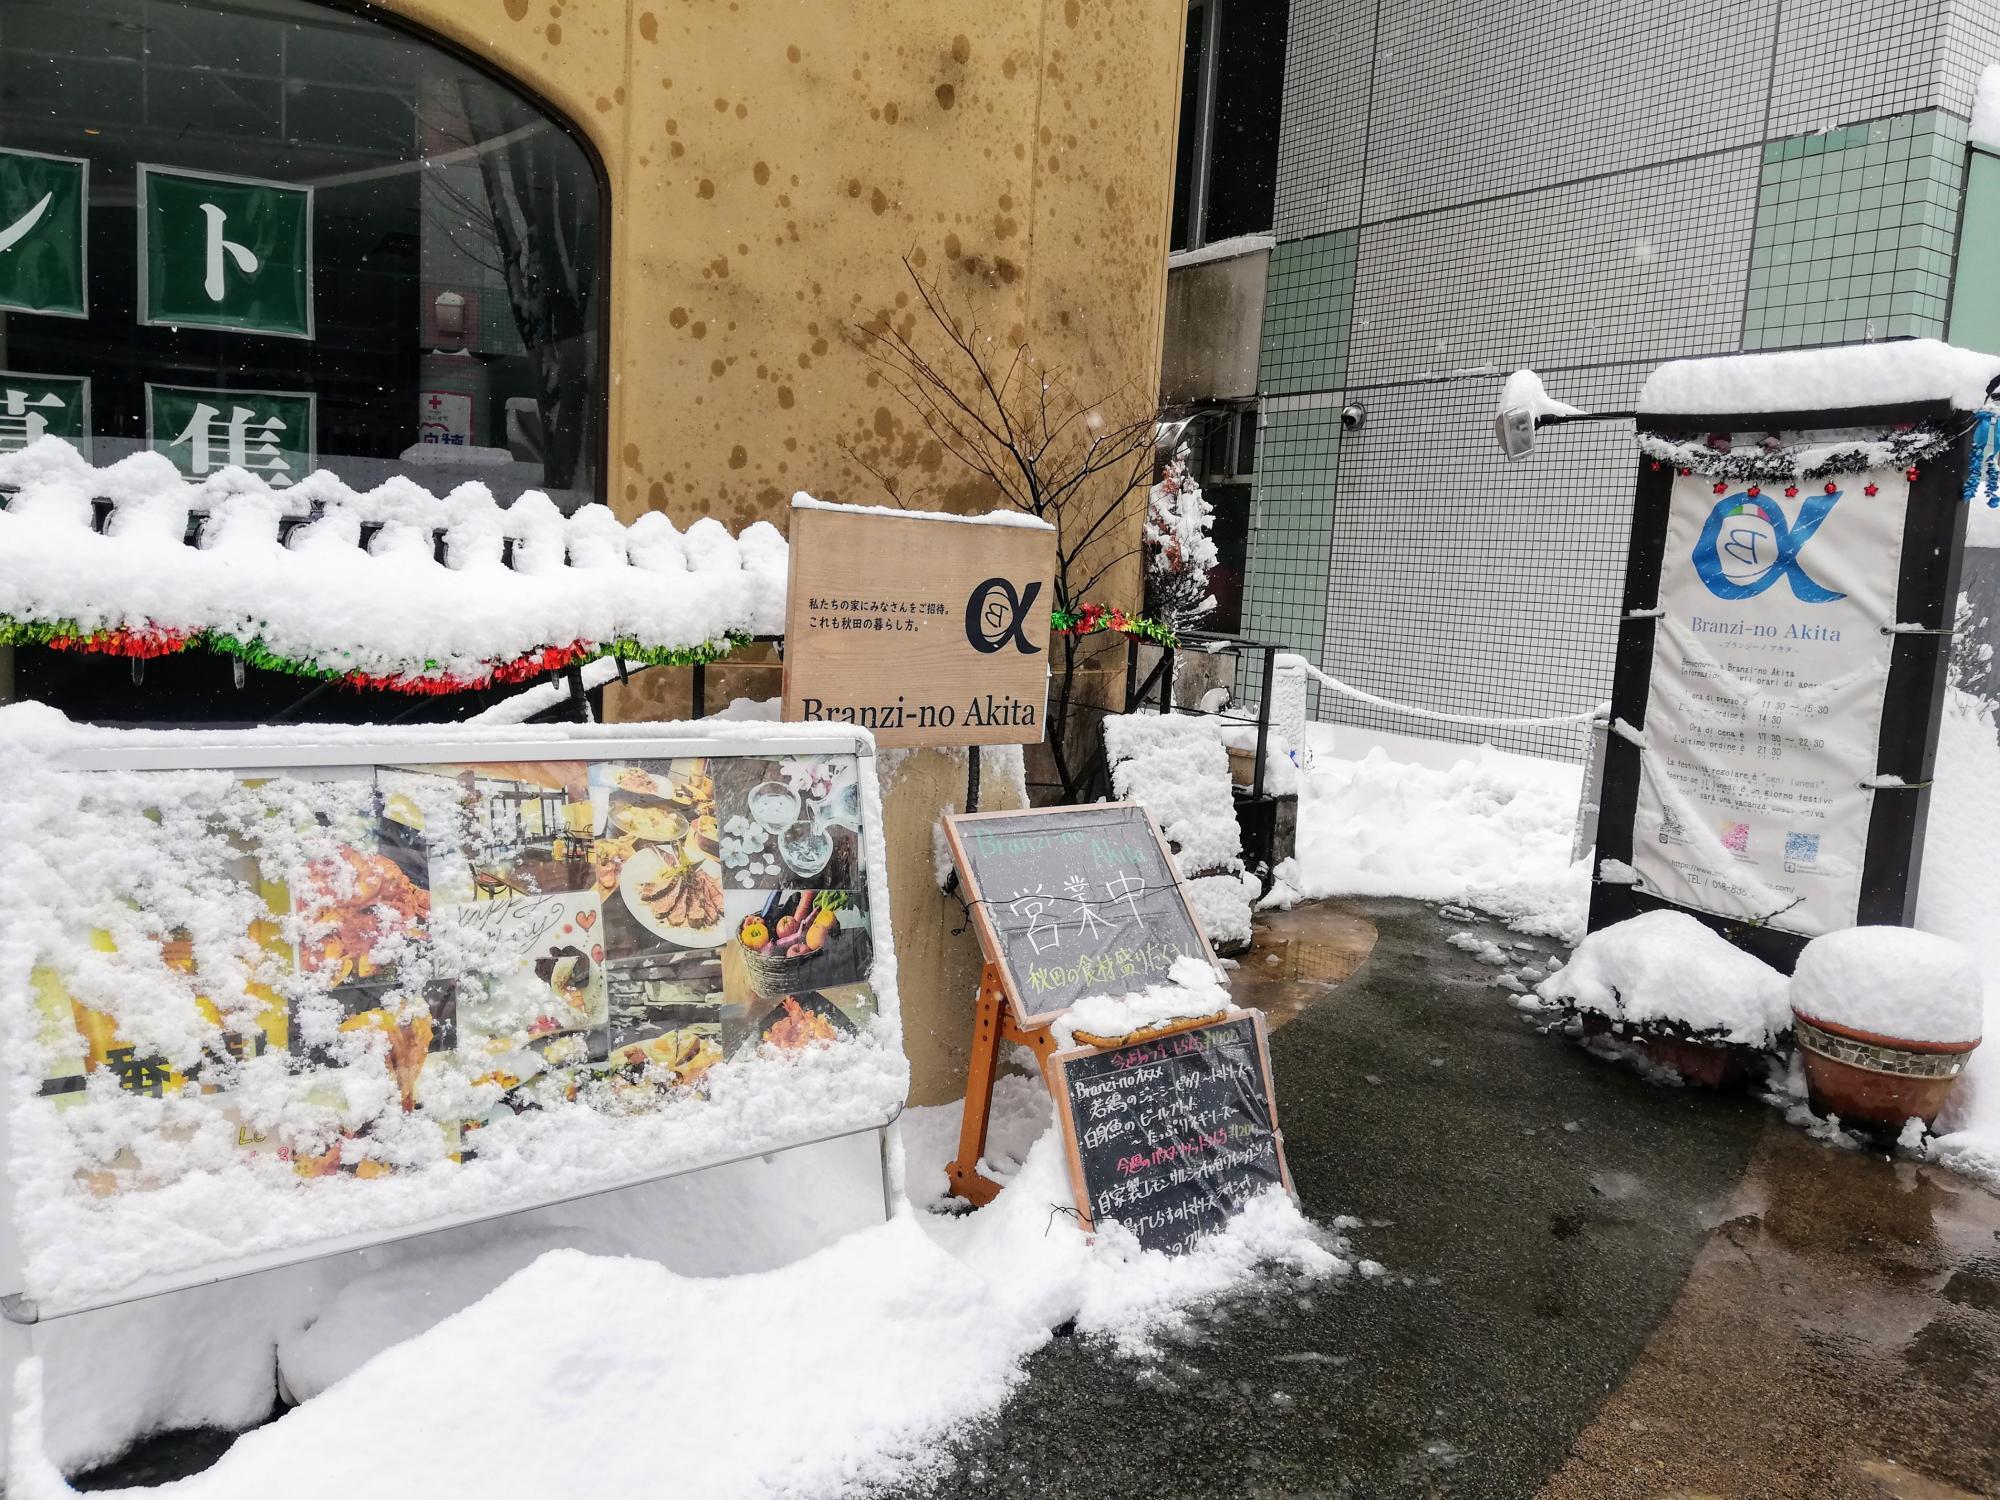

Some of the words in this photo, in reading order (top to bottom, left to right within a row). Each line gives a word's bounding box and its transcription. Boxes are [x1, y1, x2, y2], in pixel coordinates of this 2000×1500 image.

[808, 597, 950, 616] 私たちの家にみなさんをご招待。
[808, 616, 920, 632] これも秋田の暮らし方。
[1691, 616, 1777, 638] Branzi-no
[1783, 623, 1841, 642] Akita
[1771, 667, 1795, 677] Akita
[961, 694, 1036, 727] Akita
[1009, 870, 1147, 955] 営業中
